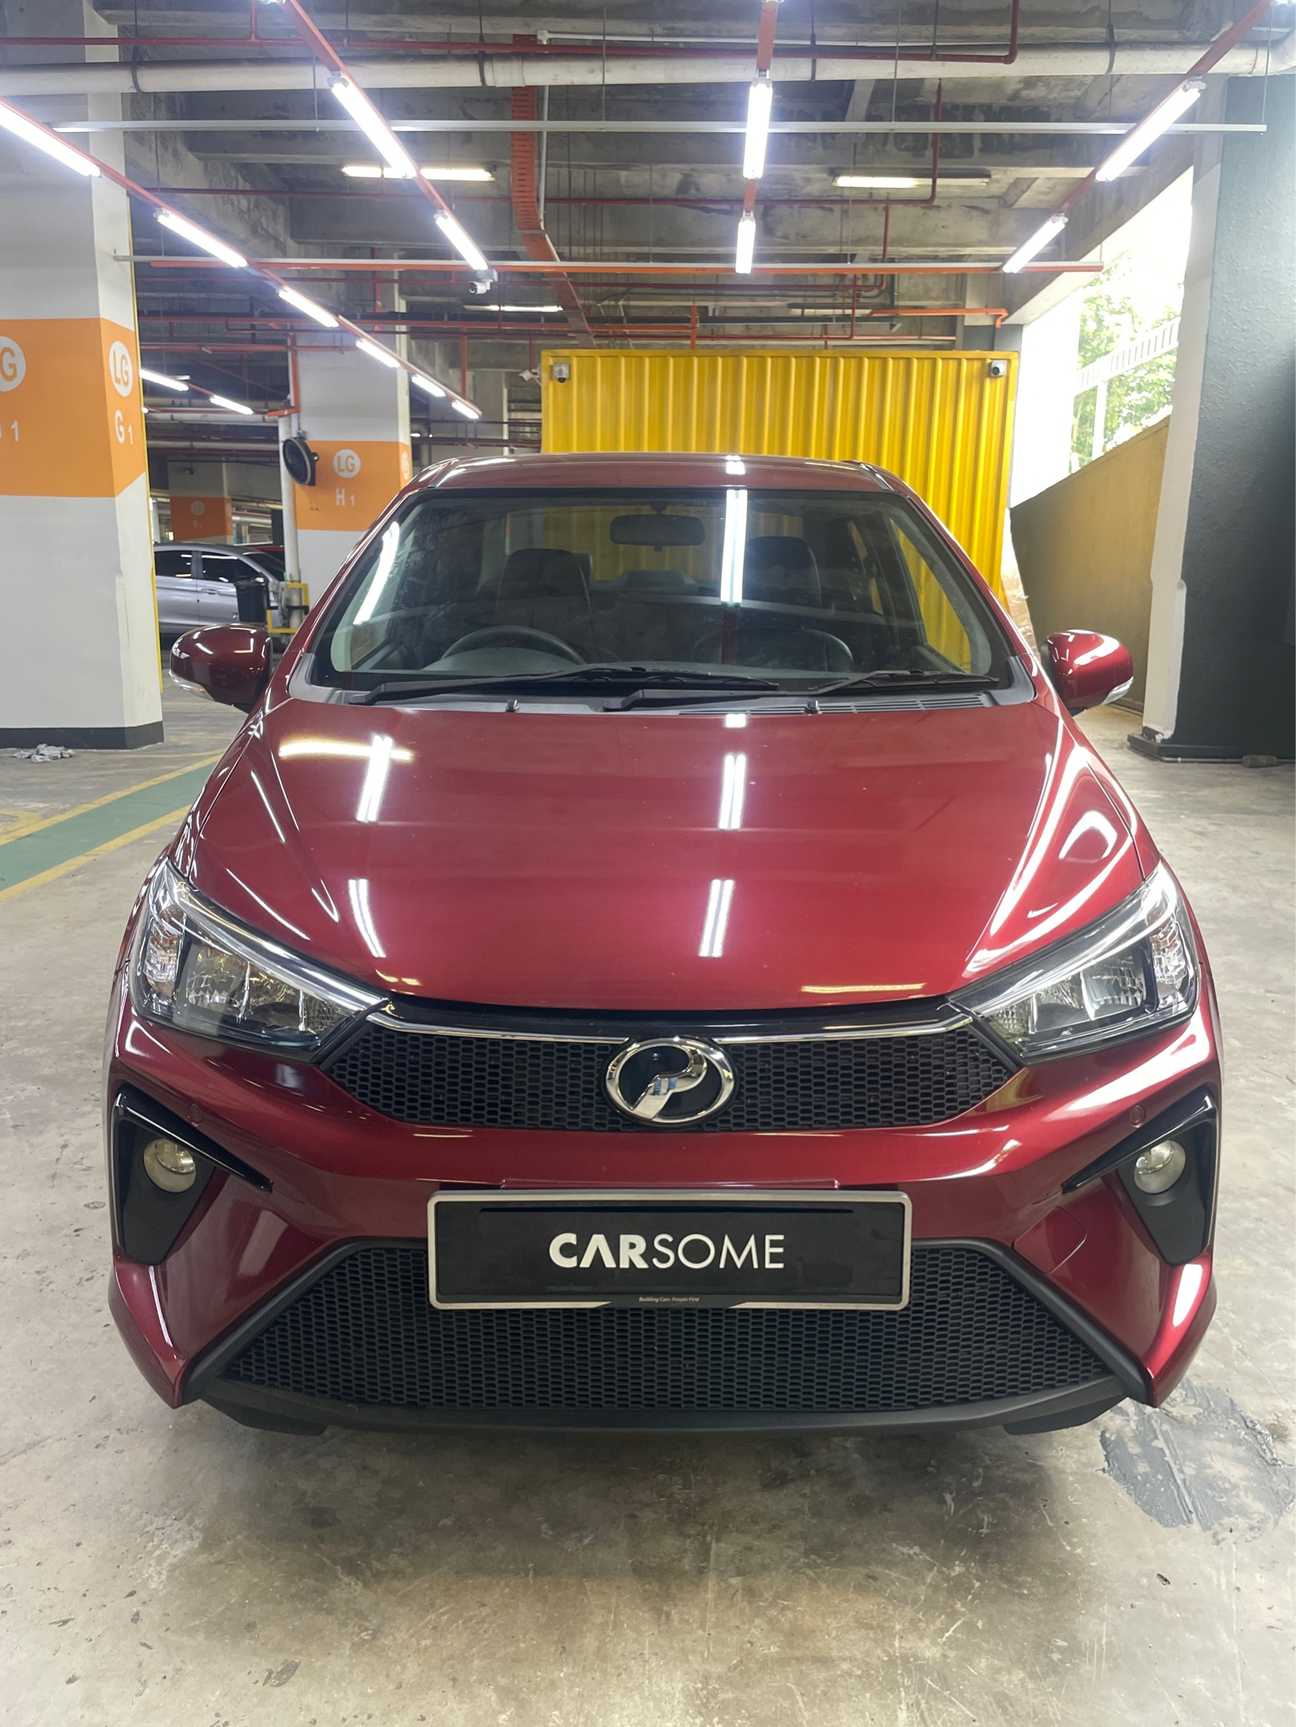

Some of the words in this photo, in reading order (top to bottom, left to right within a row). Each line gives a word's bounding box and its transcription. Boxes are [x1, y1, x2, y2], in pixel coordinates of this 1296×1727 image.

[0, 346, 18, 382] G
[113, 350, 129, 387] LG
[336, 455, 356, 473] LG
[549, 1232, 785, 1270] CARSOME
